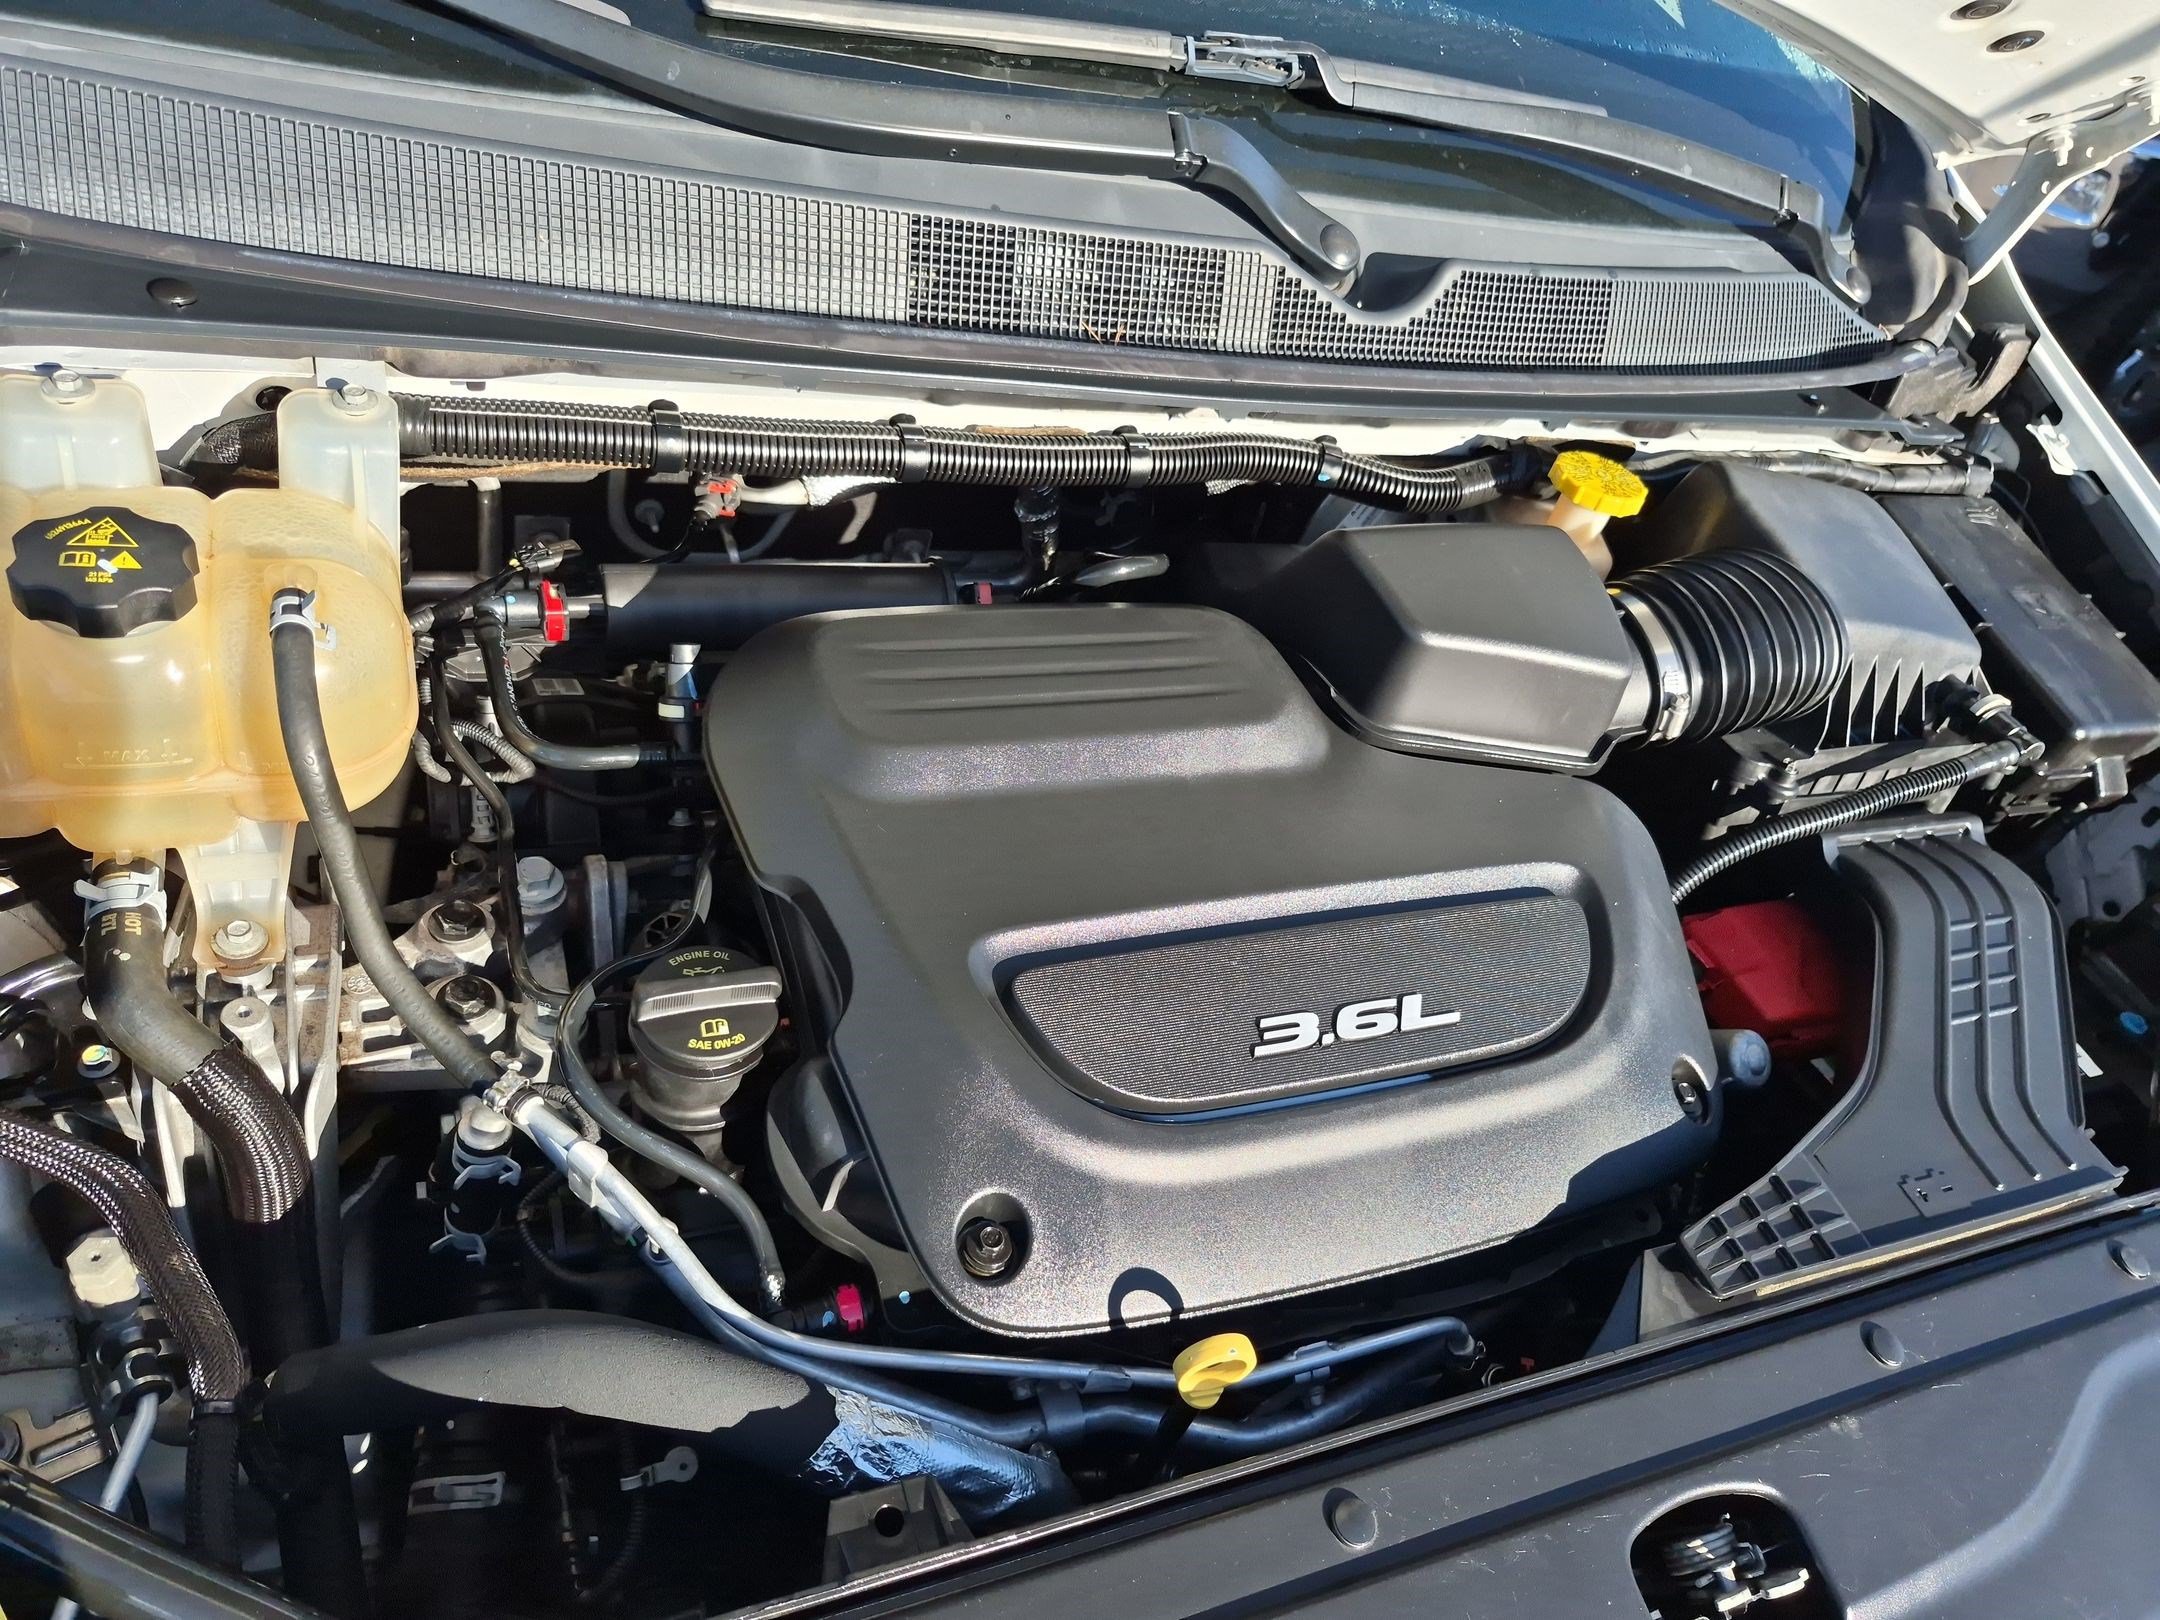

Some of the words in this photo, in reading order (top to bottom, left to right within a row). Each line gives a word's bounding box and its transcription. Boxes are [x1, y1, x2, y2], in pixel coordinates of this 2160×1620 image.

[125, 912, 141, 935] HOT
[669, 951, 710, 966] ENGINE
[713, 951, 730, 960] OIL
[1251, 993, 1461, 1059] 3.6L
[688, 1039, 712, 1049] SAE
[714, 1034, 745, 1049] 0W-20
